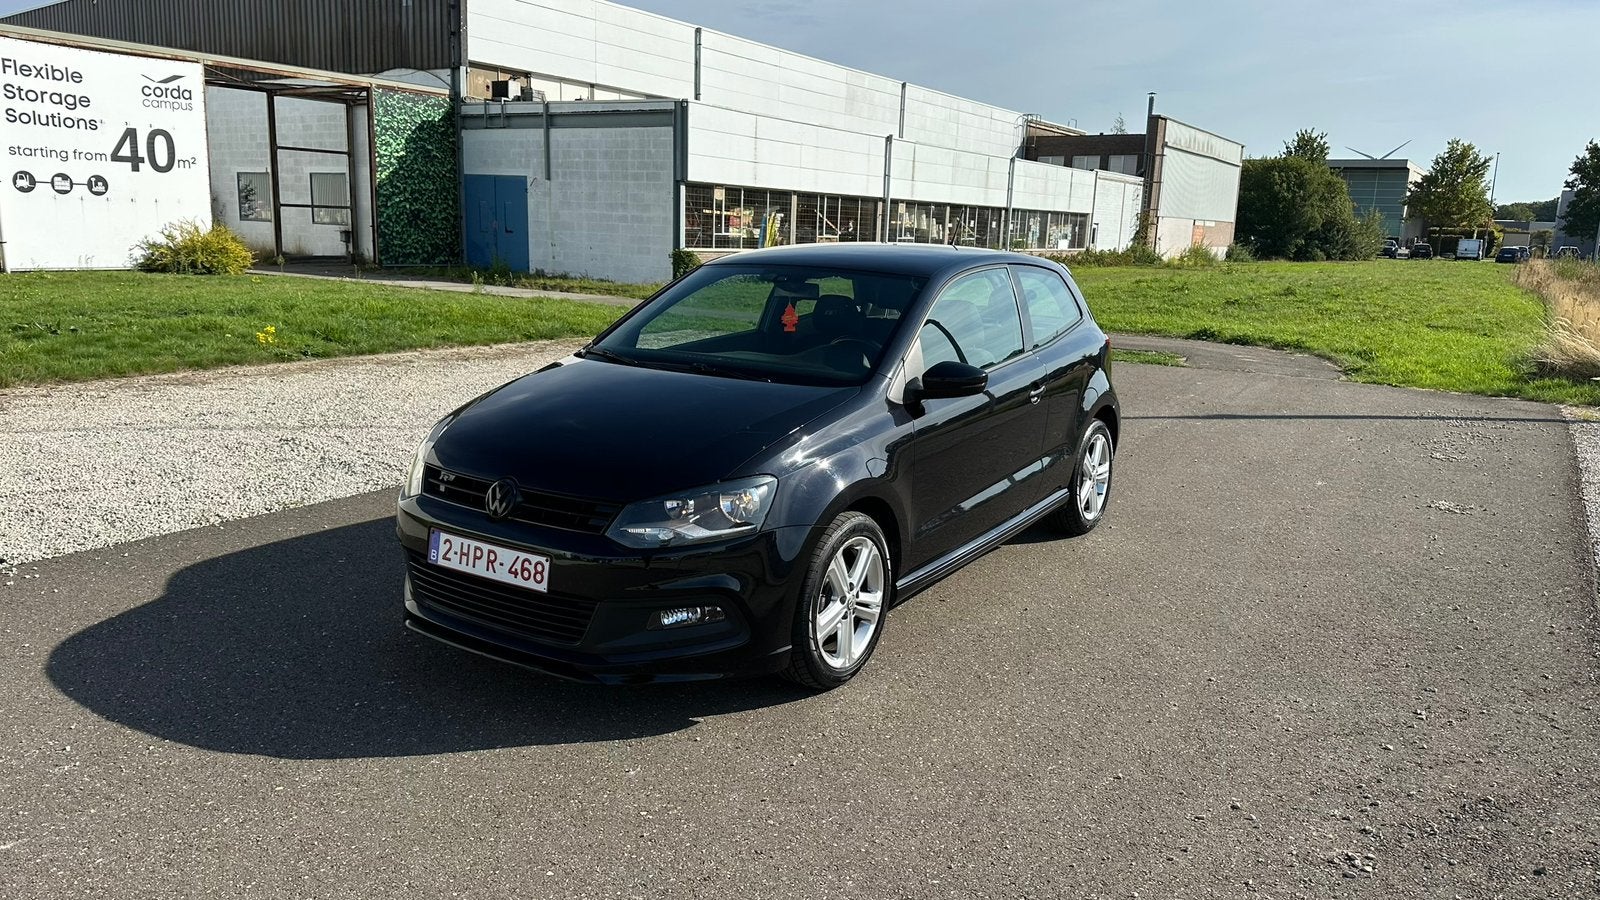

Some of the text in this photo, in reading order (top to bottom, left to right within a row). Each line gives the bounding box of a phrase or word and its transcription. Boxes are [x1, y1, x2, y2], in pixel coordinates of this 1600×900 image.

[1, 58, 83, 83] Flexible
[3, 83, 91, 110] Storage
[141, 85, 193, 101] corda
[142, 98, 193, 112] campus
[5, 108, 99, 131] Solutions
[8, 144, 69, 162] starting
[72, 149, 108, 162] from
[110, 127, 176, 173] 40
[430, 549, 437, 561] B
[442, 538, 545, 584] 2-HPR-468
